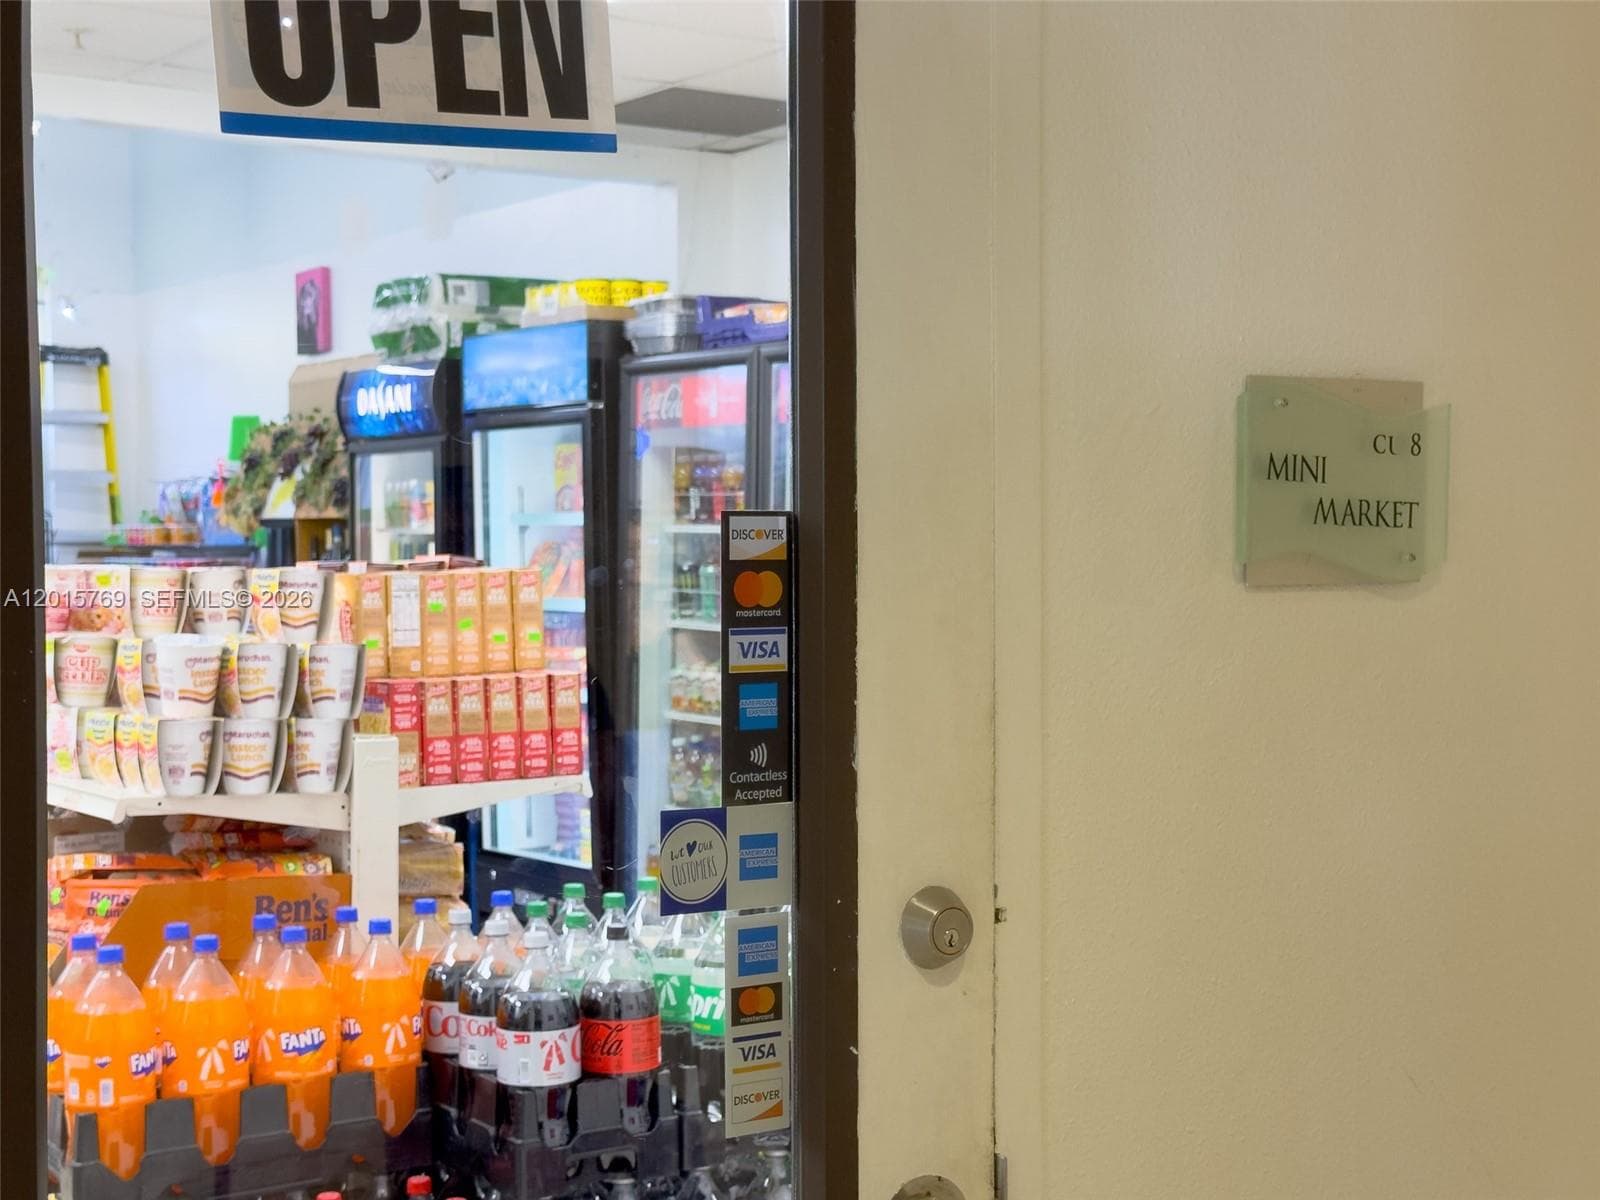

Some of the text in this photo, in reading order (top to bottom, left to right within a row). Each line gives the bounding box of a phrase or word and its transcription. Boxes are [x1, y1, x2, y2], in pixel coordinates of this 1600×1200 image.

[245, 0, 589, 120] OPEN
[1411, 432, 1422, 456] 8
[1267, 452, 1327, 484] MINI
[1313, 497, 1420, 529] MARKET
[731, 529, 784, 540] DISCOVER
[735, 608, 781, 618] mastercard
[737, 641, 780, 659] VISA
[740, 698, 777, 708] AMERICAN
[729, 769, 788, 784] Contactless
[735, 785, 782, 801] Accepted
[740, 847, 777, 858] AMERICAN
[747, 857, 779, 868] EXPRESS
[671, 856, 718, 887] CUSTOMERS
[256, 893, 328, 922] Ben's
[738, 941, 777, 953] AMERICAN
[746, 951, 778, 962] EXPRESS
[279, 1028, 326, 1050] FANTA
[738, 1043, 777, 1062] VISA
[733, 1089, 781, 1106] DISCOVER
